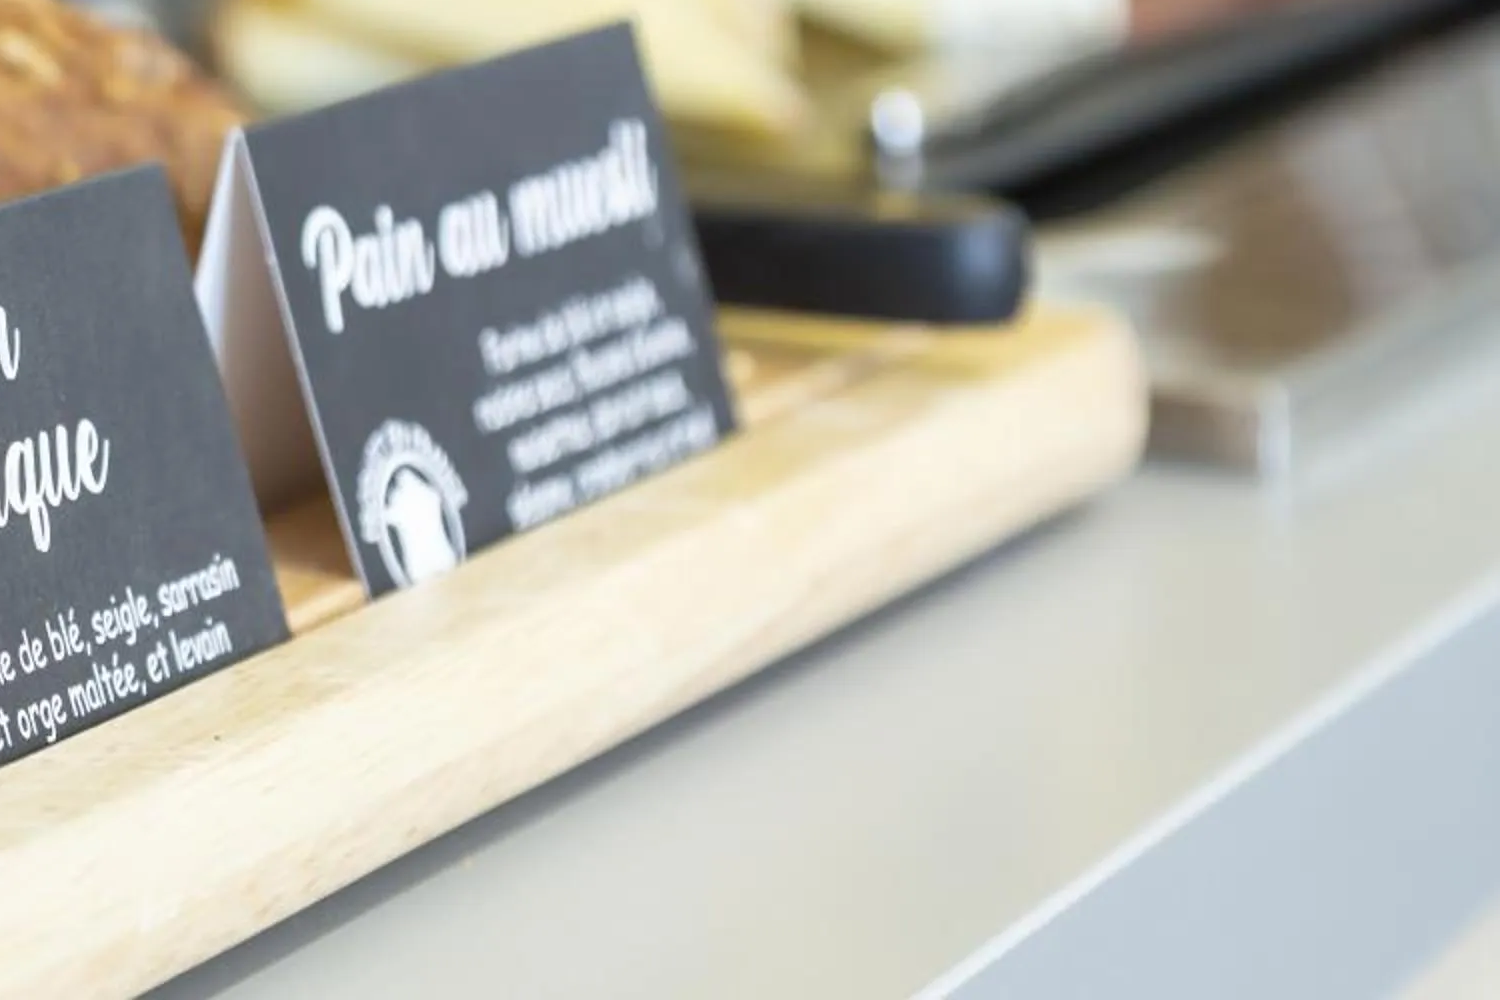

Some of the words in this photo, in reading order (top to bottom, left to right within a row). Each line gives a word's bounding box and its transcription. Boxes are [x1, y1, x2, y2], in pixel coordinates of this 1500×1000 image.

[301, 204, 435, 334] Pain
[438, 188, 510, 278] au
[18, 629, 47, 674] de
[45, 607, 92, 656] blé,
[91, 586, 160, 646] seigle,
[157, 553, 241, 617] sarrasin
[17, 693, 67, 743] orge
[67, 652, 147, 717] maltée,
[146, 641, 171, 684] et
[168, 617, 233, 673] levain
